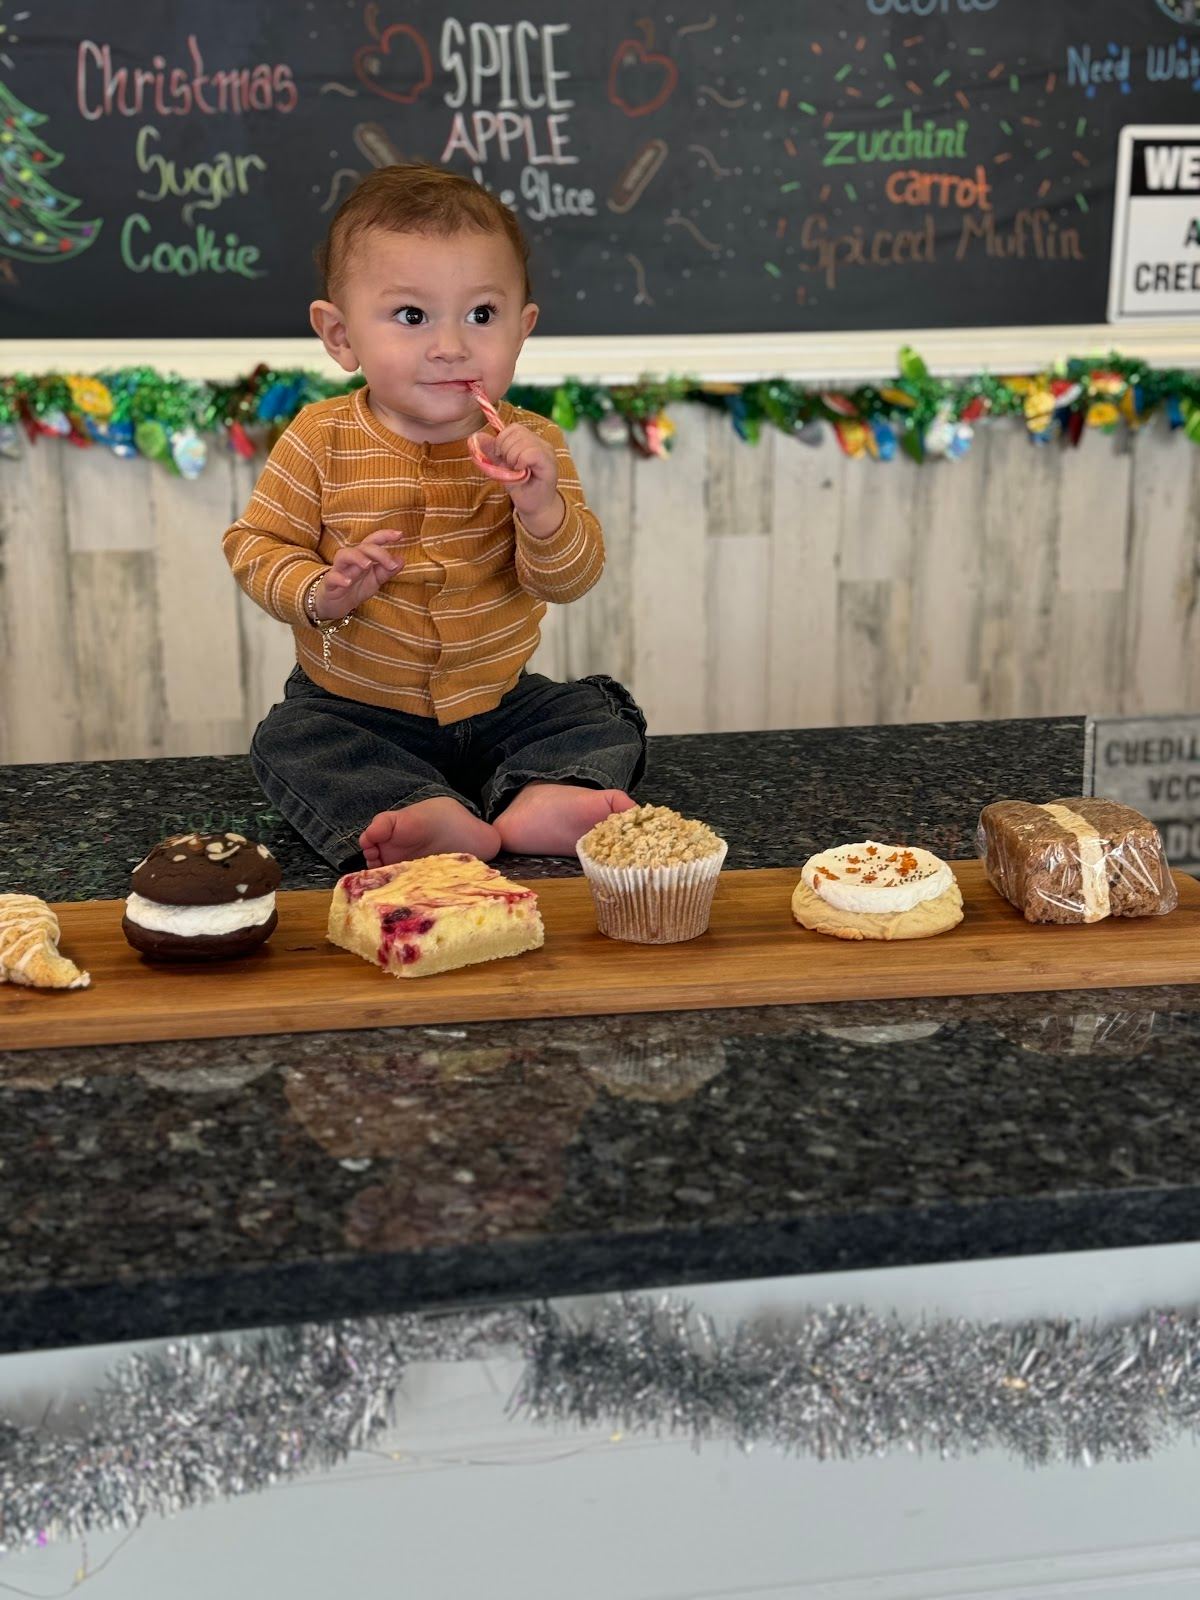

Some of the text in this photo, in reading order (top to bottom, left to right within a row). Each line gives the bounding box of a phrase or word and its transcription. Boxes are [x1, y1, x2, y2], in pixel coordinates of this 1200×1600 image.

[77, 34, 299, 120] Christmas
[440, 17, 574, 110] SPICE
[1066, 43, 1131, 88] Need
[440, 110, 580, 164] APPLE
[1144, 145, 1200, 191] WE
[135, 124, 267, 228] Sugar
[885, 165, 993, 210] carrot
[120, 212, 268, 279] Cookie
[800, 211, 1084, 289] Spiced Muffin
